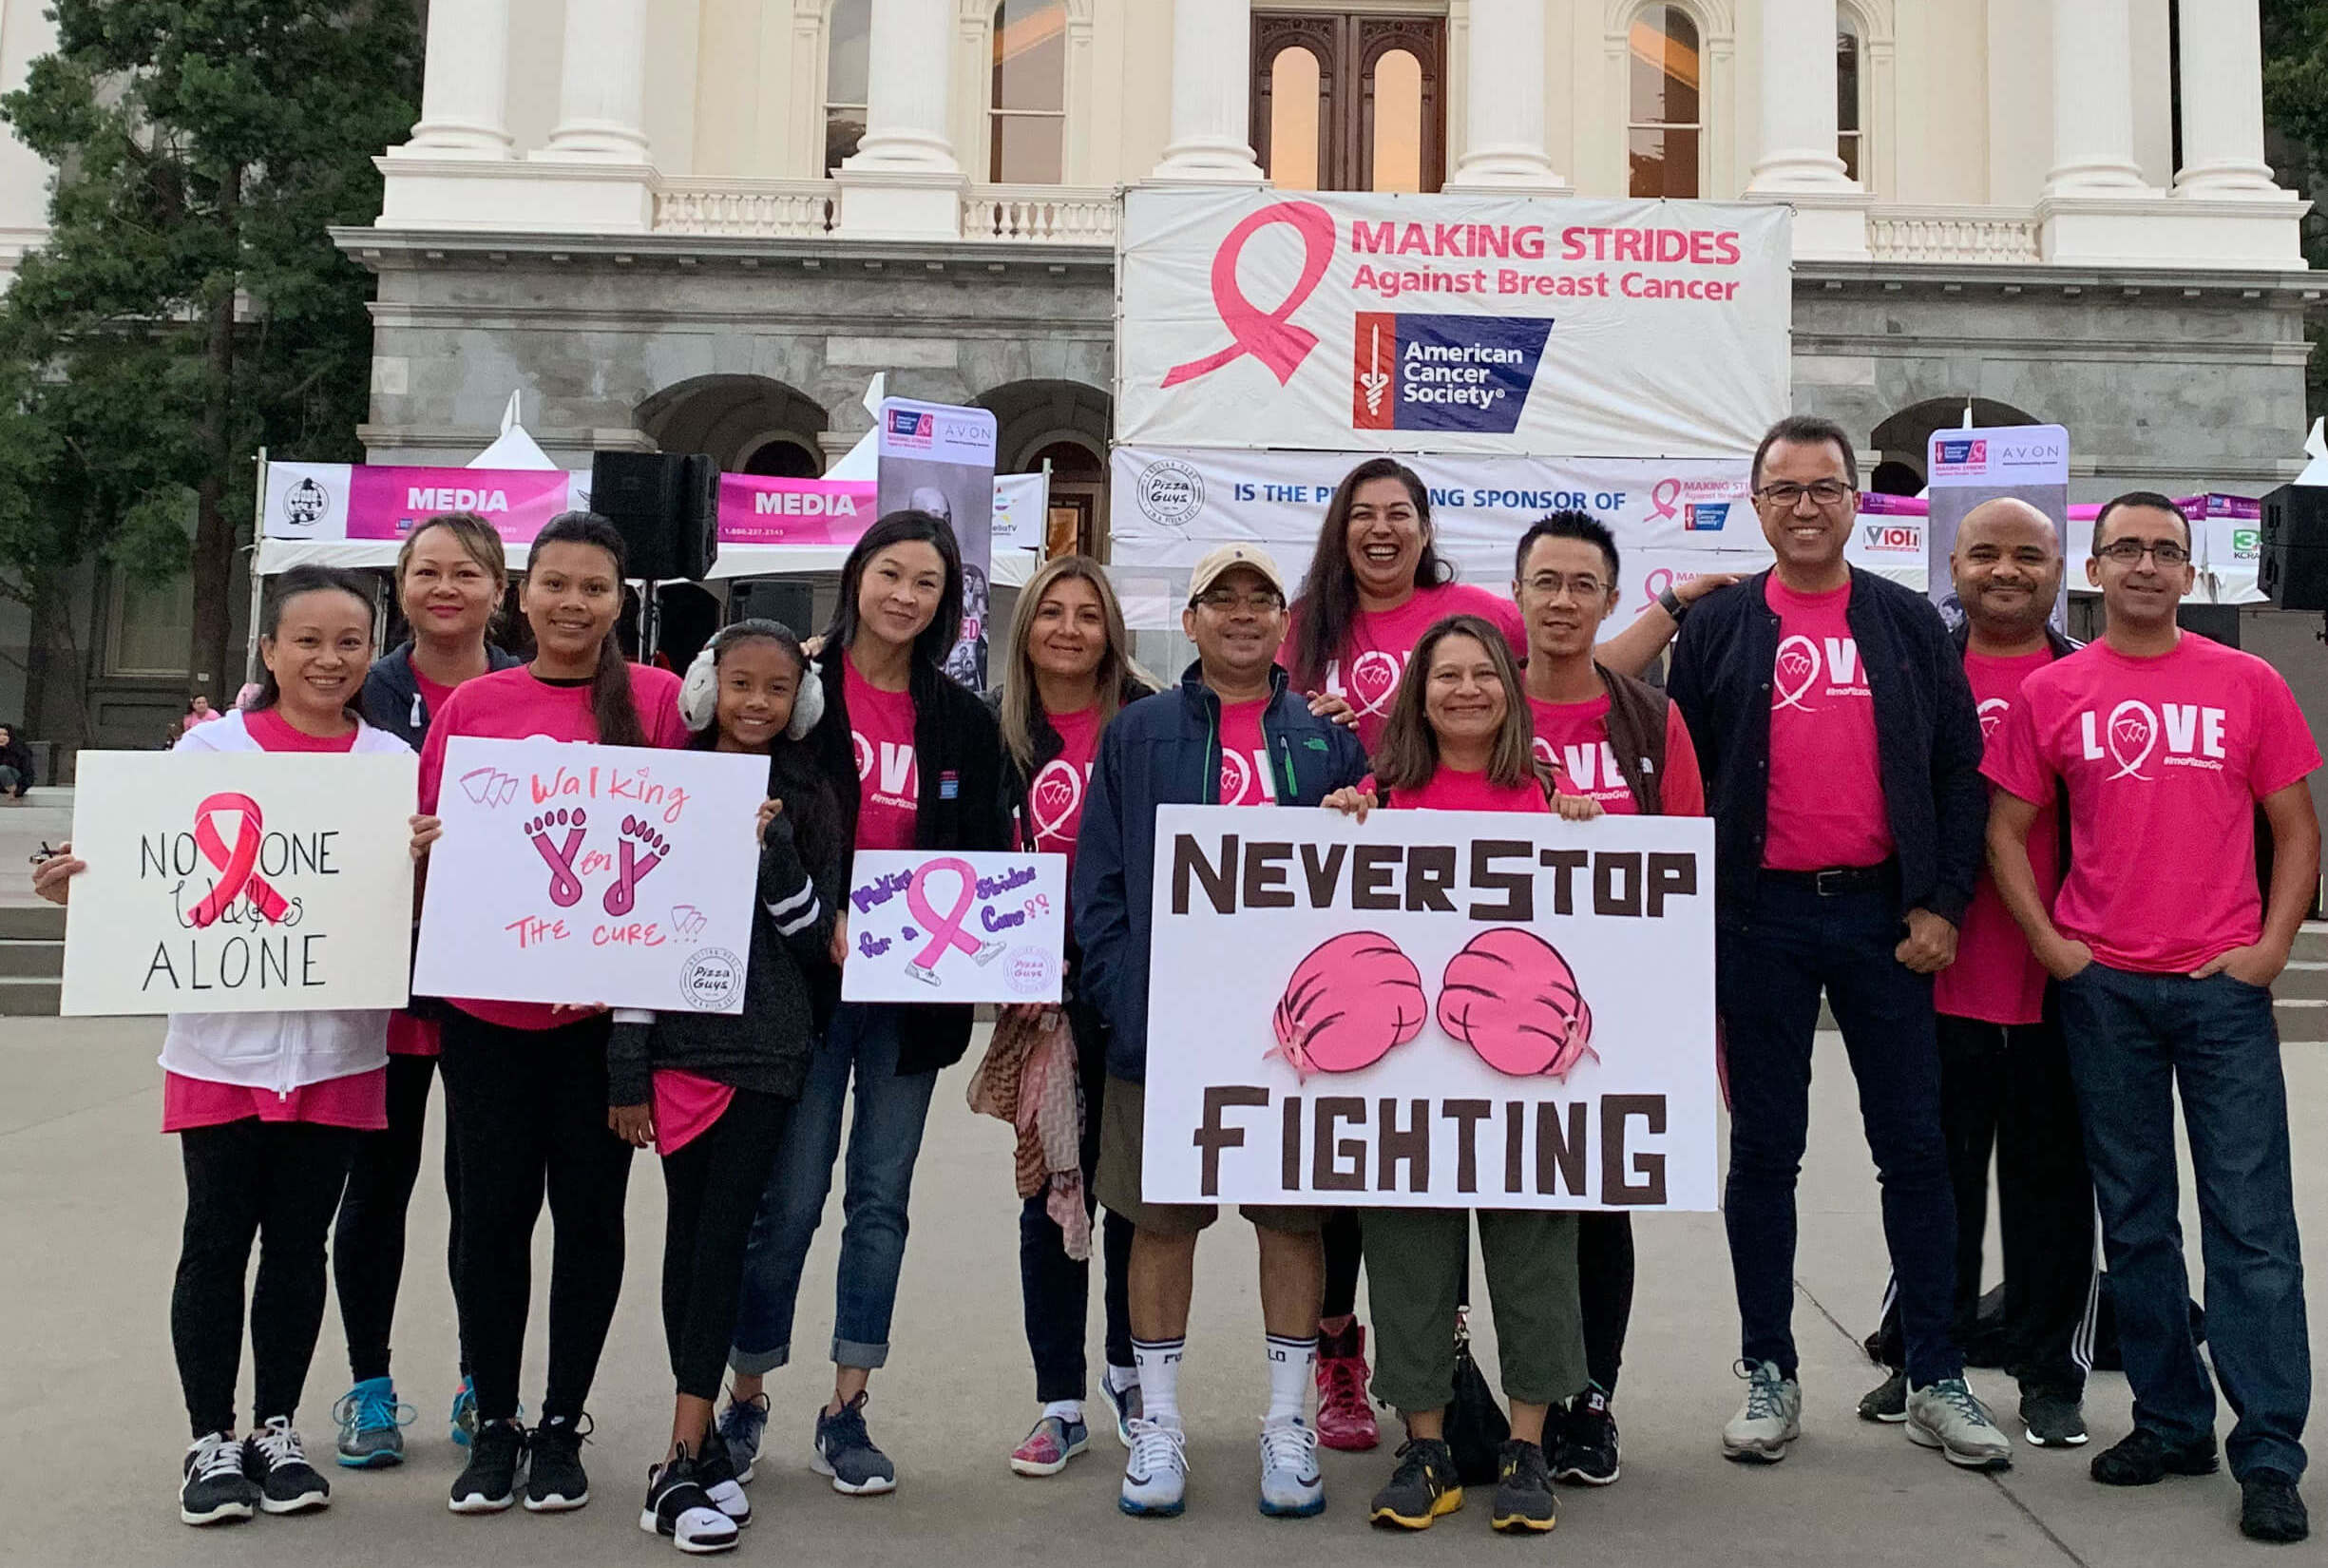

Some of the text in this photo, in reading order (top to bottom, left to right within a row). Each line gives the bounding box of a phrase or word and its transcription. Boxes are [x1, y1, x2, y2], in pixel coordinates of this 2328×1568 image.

[1351, 220, 1742, 265] MAKING STRIDES
[1351, 264, 1741, 301] Against Breast Cancer
[1403, 341, 1524, 365] American
[1403, 362, 1490, 384] Cancer
[945, 425, 991, 440] AVON
[2002, 445, 2059, 459] AVON
[1151, 479, 1190, 490] Pizza
[1234, 484, 1256, 502] IS
[1263, 484, 1307, 503] THE
[408, 487, 508, 512] MEDIA
[754, 492, 857, 517] MEDIA
[1151, 490, 1188, 505] Guys
[1473, 489, 1588, 509] SPONSOR
[1594, 491, 1627, 510] OF
[530, 766, 692, 824] Walking
[142, 831, 340, 879] NO ONE
[1171, 832, 1698, 922] NEVER STOP
[168, 877, 303, 933] Walks
[505, 914, 666, 948] THE CURE
[858, 930, 892, 959] for
[142, 934, 328, 991] ALONE
[694, 966, 731, 978] Pizza
[693, 978, 729, 991] Guys
[1193, 1085, 1668, 1206] FIGHTING
